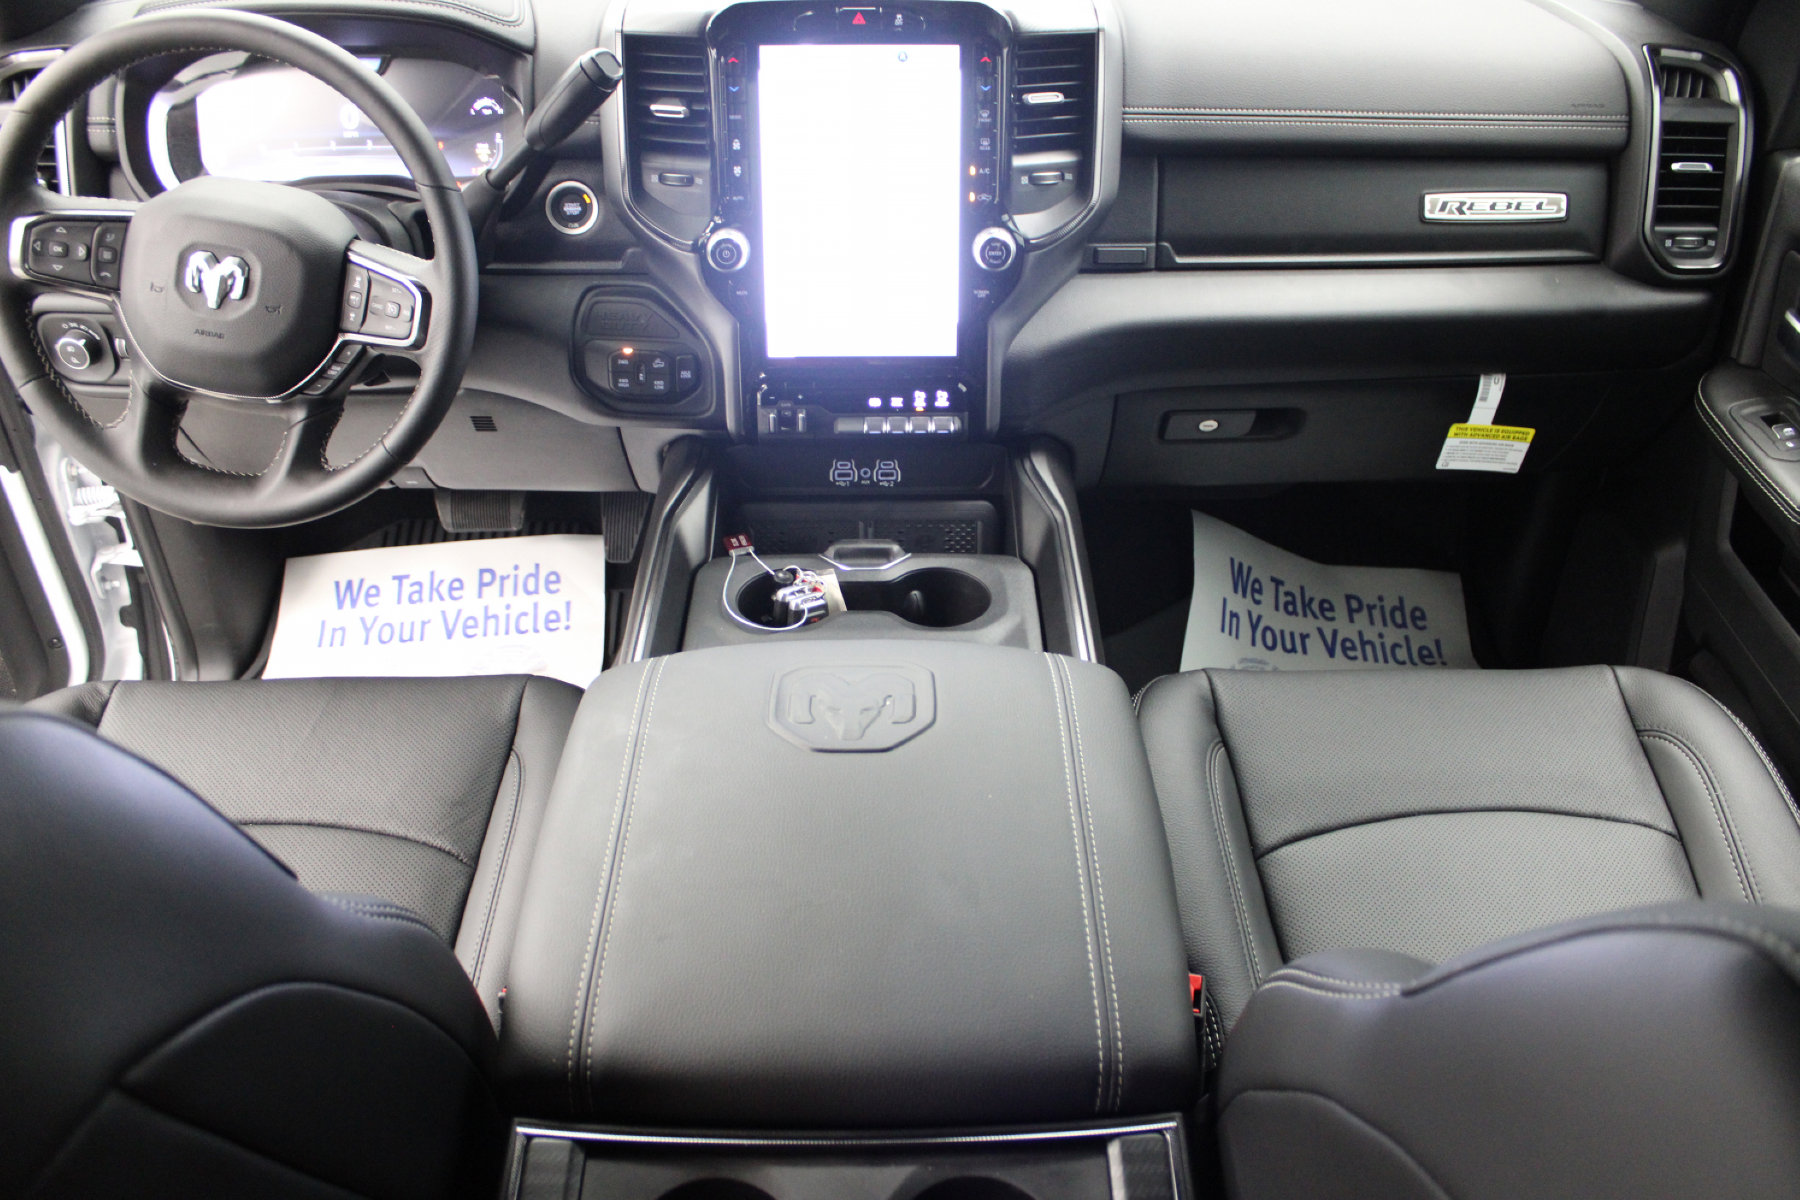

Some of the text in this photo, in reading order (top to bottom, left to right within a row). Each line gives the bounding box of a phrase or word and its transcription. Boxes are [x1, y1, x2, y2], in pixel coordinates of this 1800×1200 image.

[1437, 199, 1558, 216] REBEL
[334, 563, 562, 610] We Take Pride
[1229, 556, 1427, 631] We Take Pride
[317, 600, 572, 648] In Your Vehicle!
[1221, 597, 1448, 666] In Your Vehicle!
